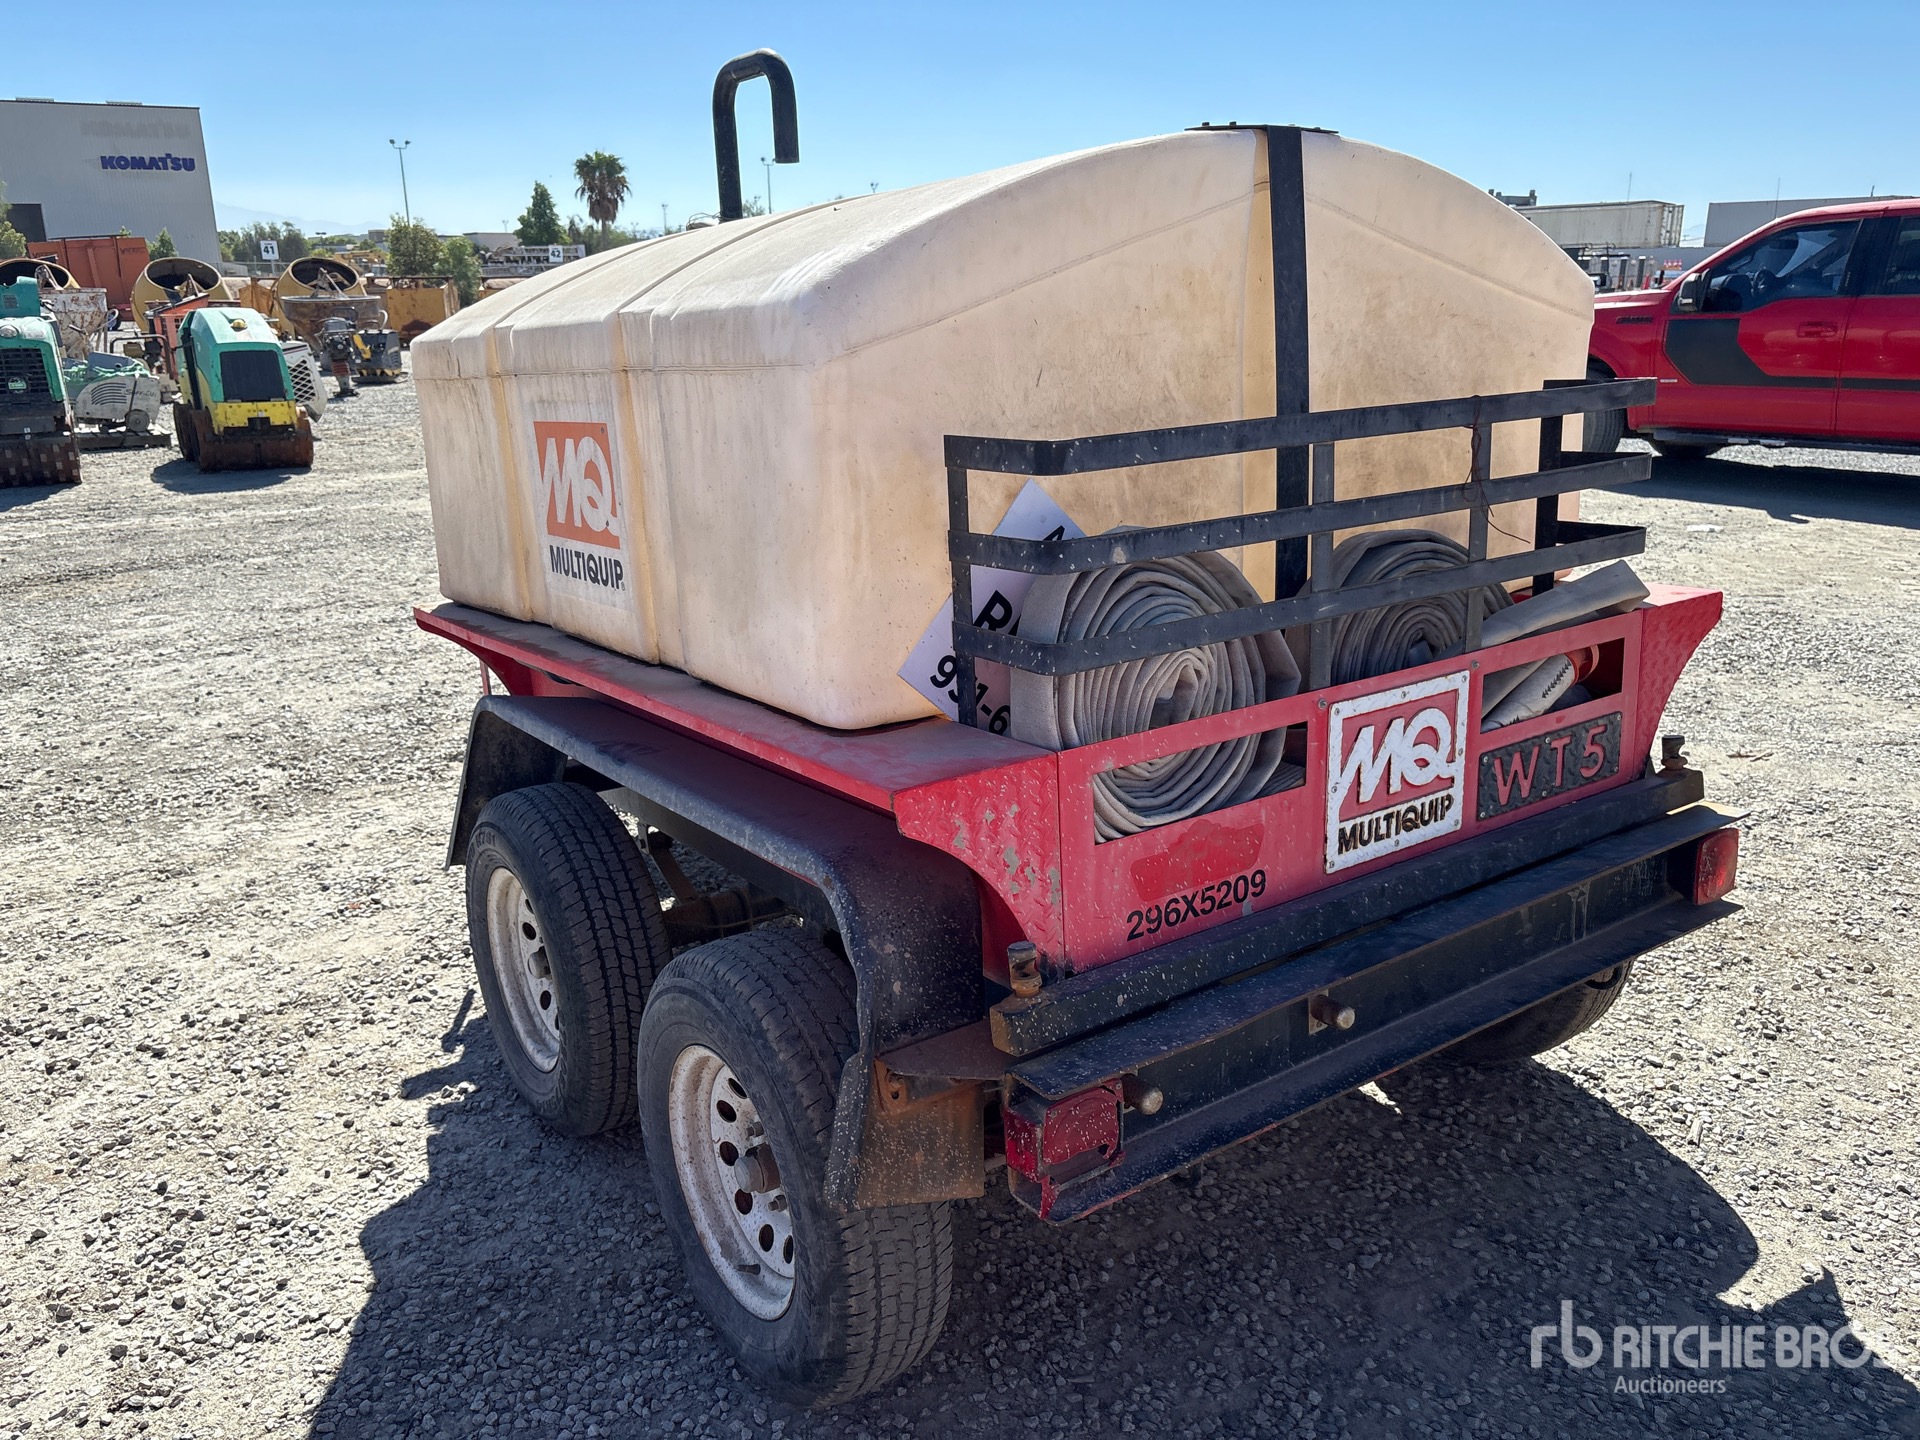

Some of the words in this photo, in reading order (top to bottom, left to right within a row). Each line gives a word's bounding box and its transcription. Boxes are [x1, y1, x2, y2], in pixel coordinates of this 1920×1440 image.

[100, 153, 196, 172] KOMATSU
[263, 245, 275, 255] 41
[550, 250, 562, 258] 42
[540, 436, 620, 537] MQ
[549, 545, 624, 590] MULTIQUIP
[1337, 707, 1466, 804] MQ
[1337, 794, 1454, 855] MULTIQUIP
[1126, 869, 1267, 942] 296X5209
